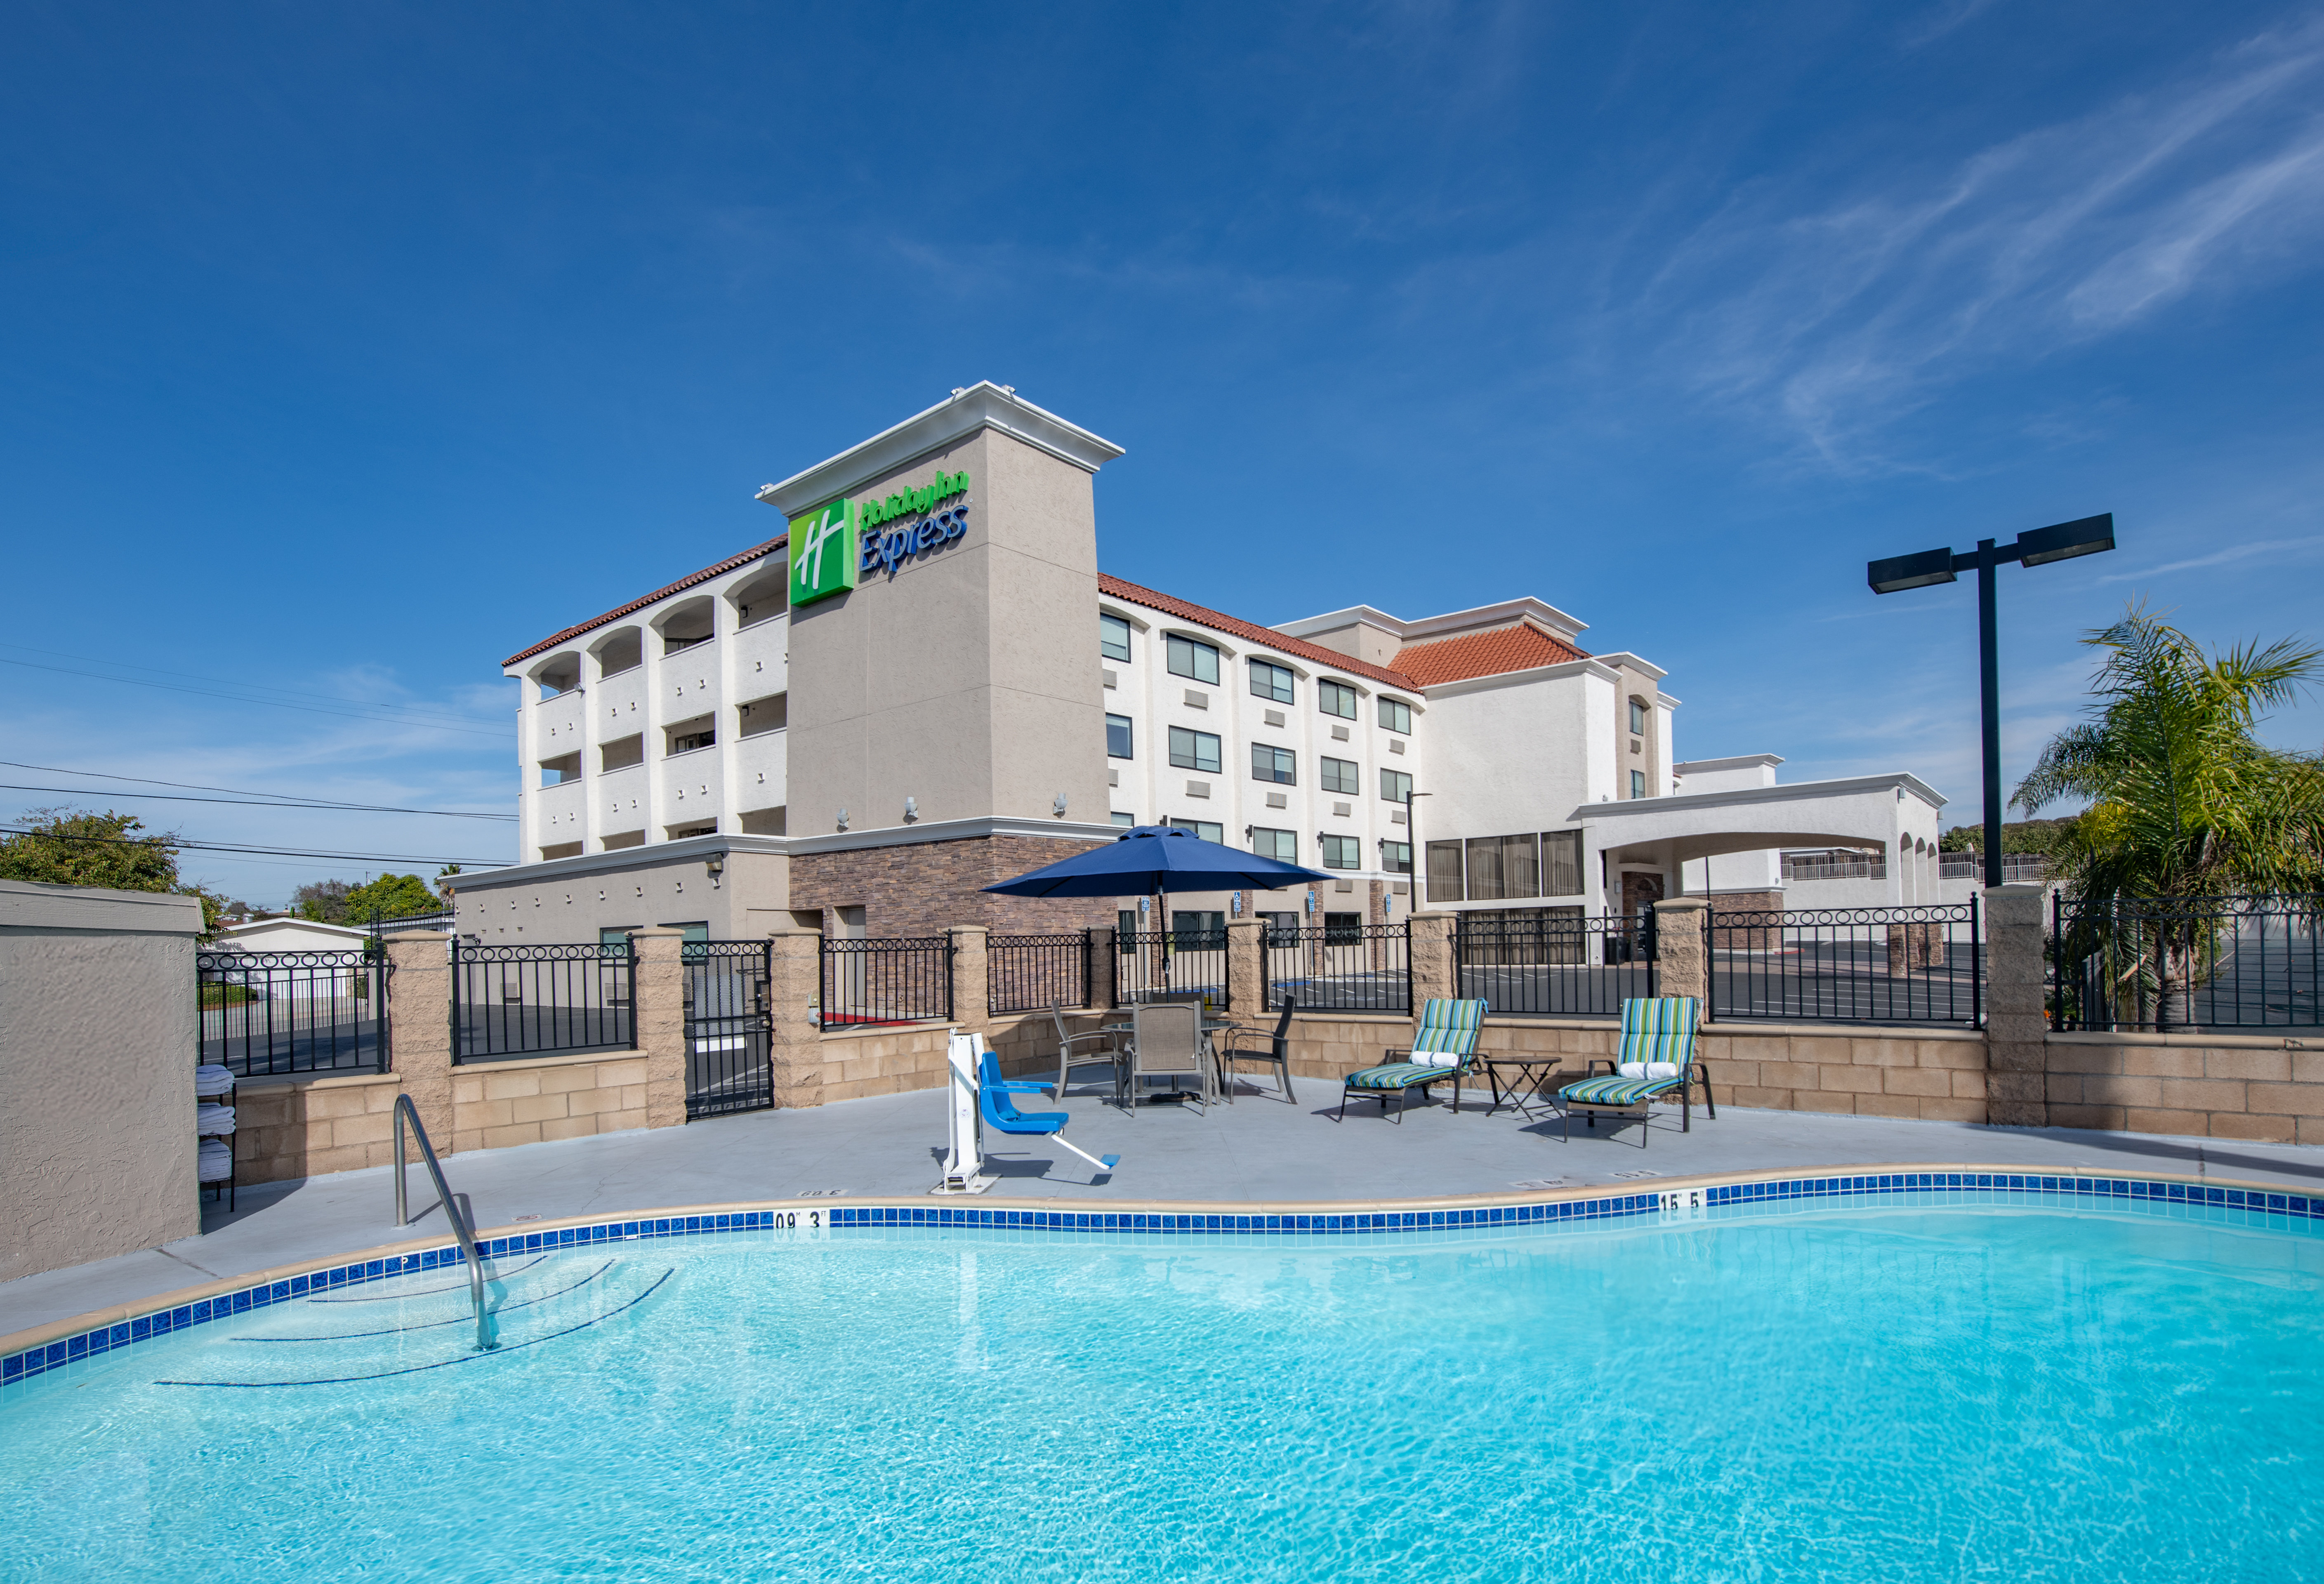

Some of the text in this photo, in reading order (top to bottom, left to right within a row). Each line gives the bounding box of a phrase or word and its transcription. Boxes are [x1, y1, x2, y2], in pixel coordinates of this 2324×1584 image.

[859, 471, 969, 531] Holiday Inn
[859, 505, 969, 572] Express
[1690, 1192, 1699, 1208] 5
[809, 1211, 820, 1228] 3
